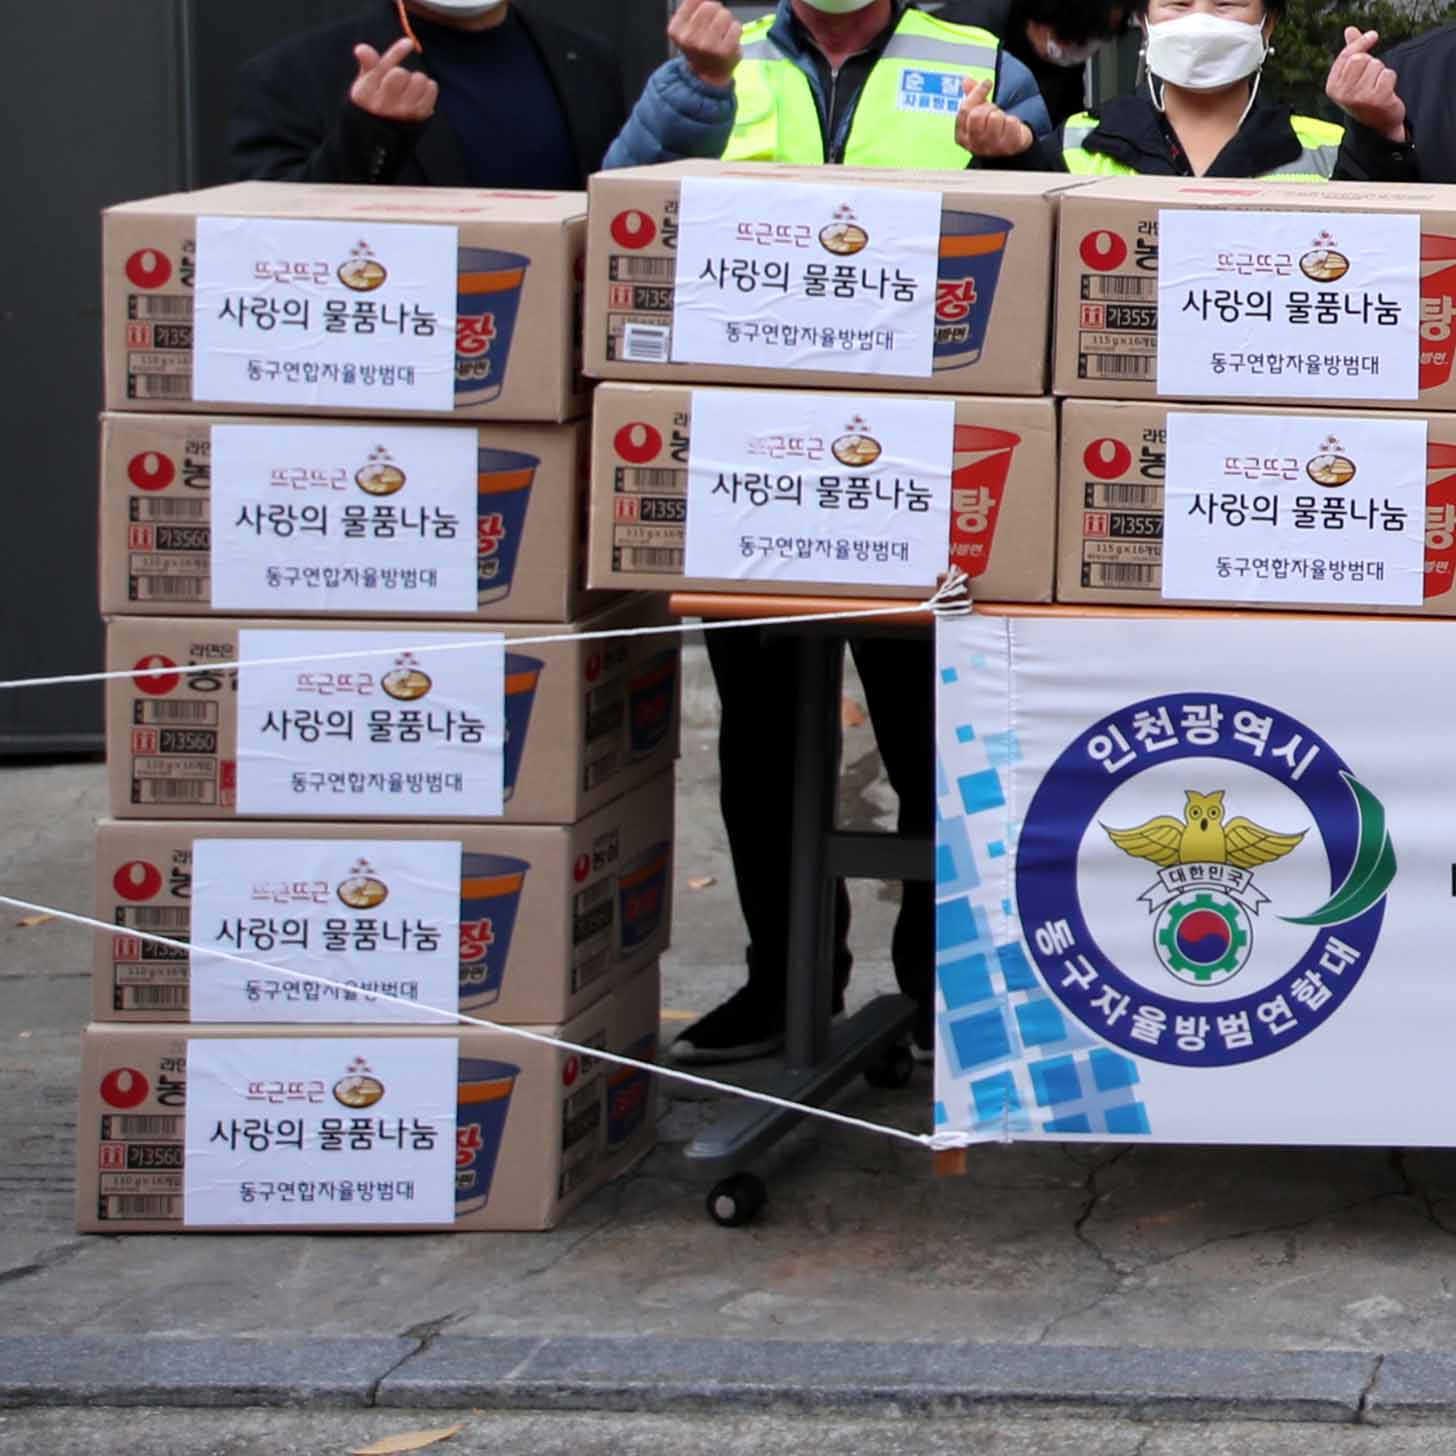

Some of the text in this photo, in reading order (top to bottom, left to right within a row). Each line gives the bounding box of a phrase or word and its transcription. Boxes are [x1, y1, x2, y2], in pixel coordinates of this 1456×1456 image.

[904, 94, 960, 112] 자율방범
[734, 221, 813, 250] 뜨근뜨근
[253, 260, 330, 286] 뜨근뜨근
[1214, 251, 1294, 278] 뜨근뜨근
[698, 256, 920, 304] 사랑의 물품나눔
[217, 295, 439, 338] 사랑의 물품나눔
[1180, 288, 1404, 327] 사랑의 물품나눔
[725, 320, 895, 352] 동구연합자율방범대
[246, 358, 416, 387] 동구연합자율방범대
[1209, 351, 1380, 378] 동구연합자율방범대
[270, 466, 348, 492] 뜨근뜨근
[1222, 455, 1301, 482] 뜨근뜨근
[710, 471, 934, 514] 사랑의 물품나눔
[234, 503, 460, 540] 사랑의 물품나눔
[642, 498, 685, 520] 가355
[1186, 491, 1409, 533] 사랑의 물품나눔
[738, 534, 910, 563] 동구연합자율방범대
[265, 565, 438, 590] 동구연합자율방범대
[1215, 555, 1385, 583] 동구연합자율방범대
[295, 671, 375, 697] 뜨근뜨근
[259, 708, 487, 745] 사랑의 물품나눔
[1086, 702, 1320, 782] 인천광역시
[290, 770, 464, 794] 동구연합자율방범대
[1168, 864, 1247, 889] 대한민국
[214, 916, 442, 953] 사랑의 물품나눔
[1034, 918, 1361, 1052] 동구자율방범연합대
[244, 1079, 326, 1106] 뜨근뜨근
[208, 1116, 440, 1154] 사랑의 물품나눔
[239, 1179, 415, 1204] 동구연합자율방범대
